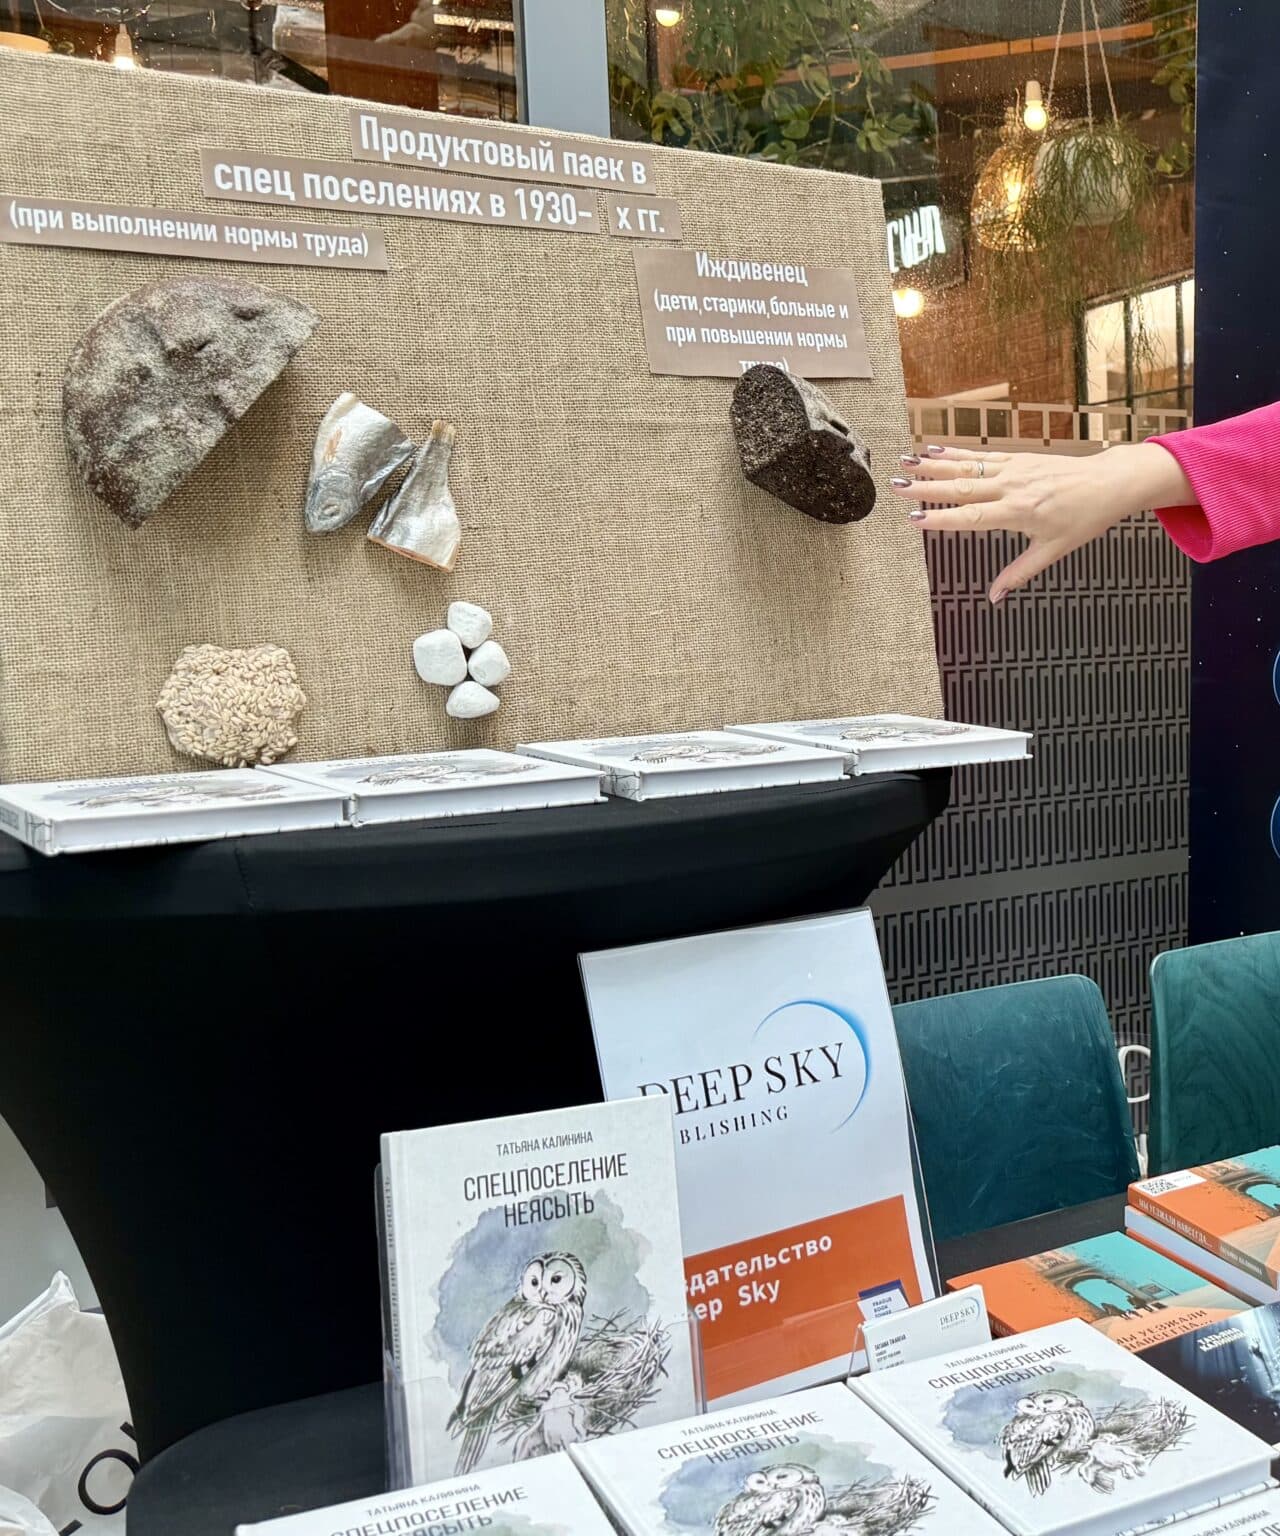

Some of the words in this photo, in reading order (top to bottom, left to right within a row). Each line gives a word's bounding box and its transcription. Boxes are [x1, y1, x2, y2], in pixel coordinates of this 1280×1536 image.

[359, 114, 555, 173] Продуктовый
[563, 151, 624, 183] паек
[632, 160, 647, 185] в
[214, 163, 295, 200] спец
[303, 168, 483, 217] поселениях
[491, 194, 506, 219] в
[9, 200, 64, 233] (при
[71, 209, 217, 243] выполнении
[224, 226, 298, 252] нормы
[303, 230, 369, 259] труда)
[638, 208, 666, 234] гг.
[696, 252, 809, 287] Иждивенец
[839, 303, 849, 319] и
[666, 325, 697, 348] при
[701, 327, 794, 349] повышении
[797, 331, 848, 352] нормы
[764, 1042, 844, 1094] SKY
[496, 1140, 541, 1157] ТАТЬЯНА
[542, 1130, 594, 1150] КАЛИНИНА
[464, 1153, 629, 1201] СПЕЦПОСЕЛЕНИЕ
[504, 1192, 595, 1228] НЕЯСЫТЬ
[738, 1279, 781, 1307] Sky
[928, 1343, 1072, 1390] СПЕЦПОСЕЛЕНИЕ
[973, 1364, 1057, 1393] НЕЯСЫТЬ
[657, 1410, 824, 1461] СПЕЦПОСЕЛЕНИЕ
[681, 1421, 726, 1437] ТАТЬЯНА
[705, 1434, 801, 1464] НЕЯСЫТЬ
[366, 1499, 418, 1518] ТАТЬЯНА
[419, 1483, 482, 1504] КАЛИНИНА
